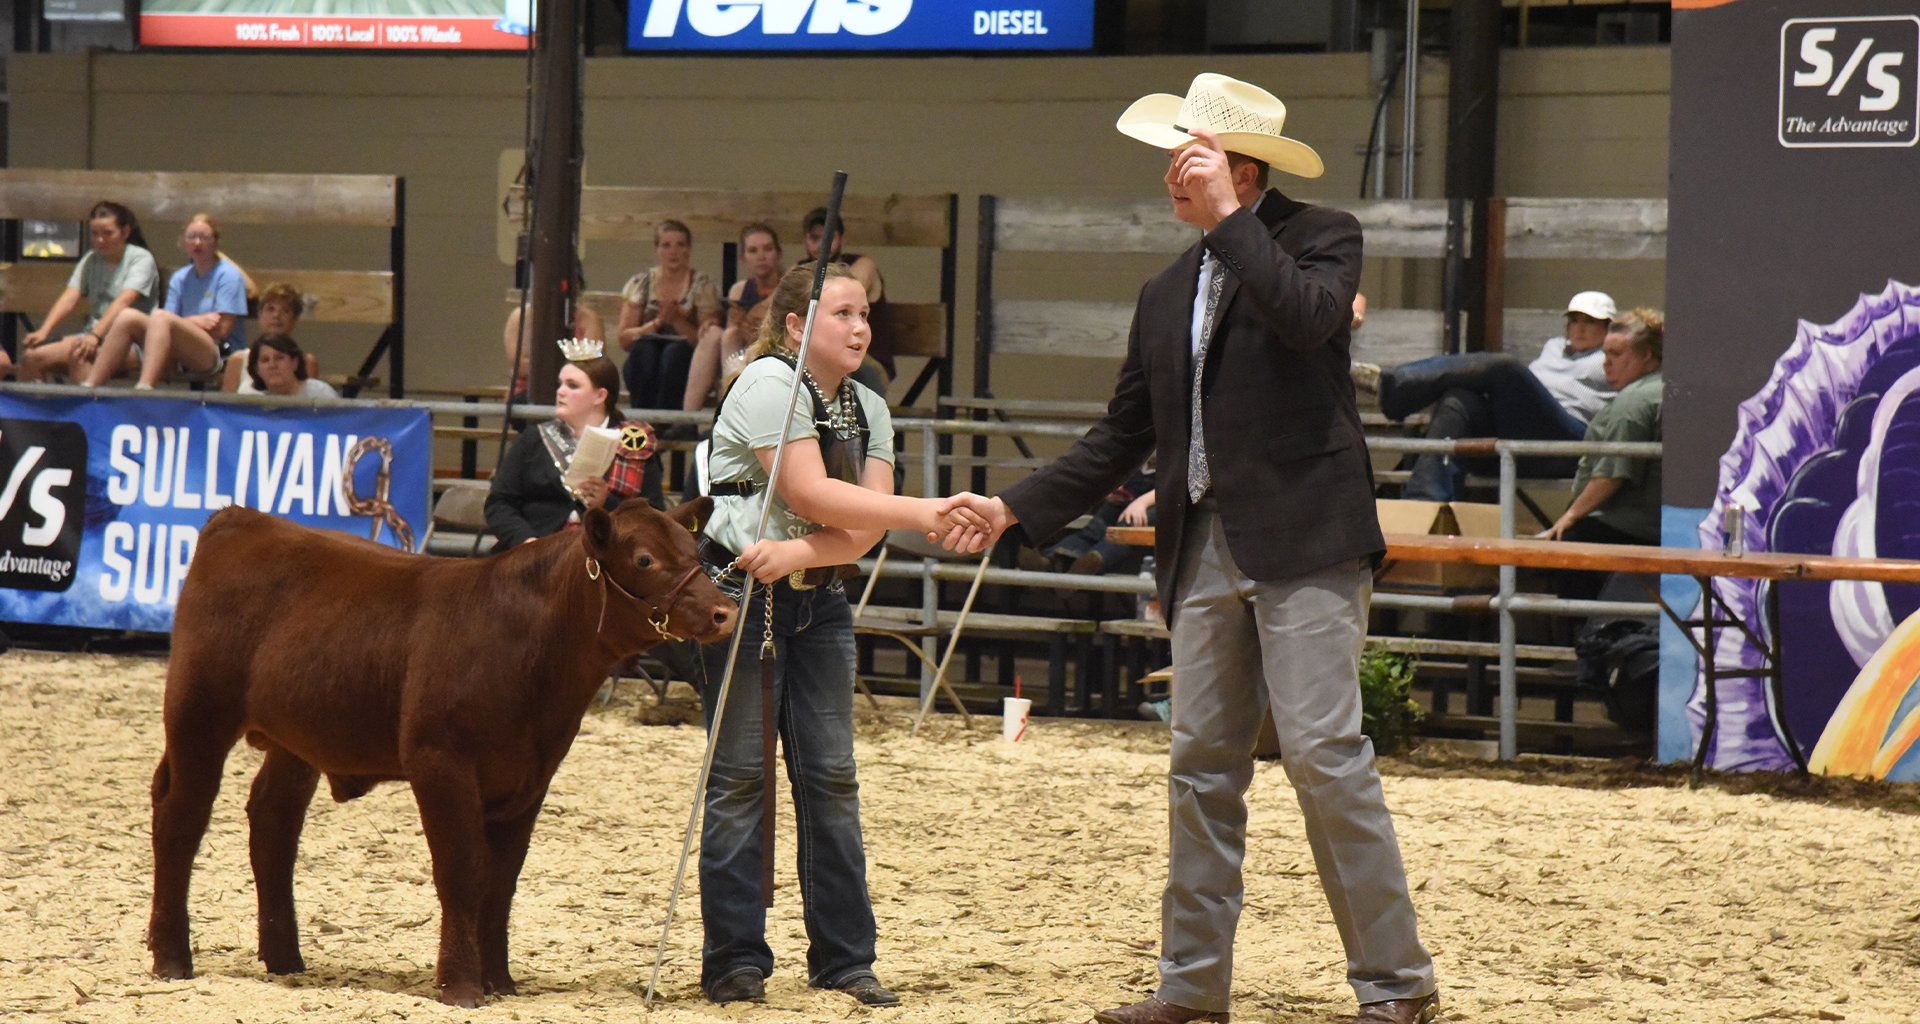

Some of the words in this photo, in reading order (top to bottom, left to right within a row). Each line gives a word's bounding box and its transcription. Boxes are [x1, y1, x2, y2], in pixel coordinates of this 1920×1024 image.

[236, 24, 269, 41] 100%
[269, 24, 300, 41] Fresh
[311, 25, 343, 42] 100%
[345, 25, 375, 42] Local
[386, 25, 419, 42] 100%
[974, 10, 1048, 35] DIESEL
[1793, 27, 1904, 112] S/S
[1786, 116, 1816, 133] The
[1819, 116, 1908, 136] Advantage
[107, 424, 358, 517] SULLIVAN
[0, 549, 72, 582] dvantage
